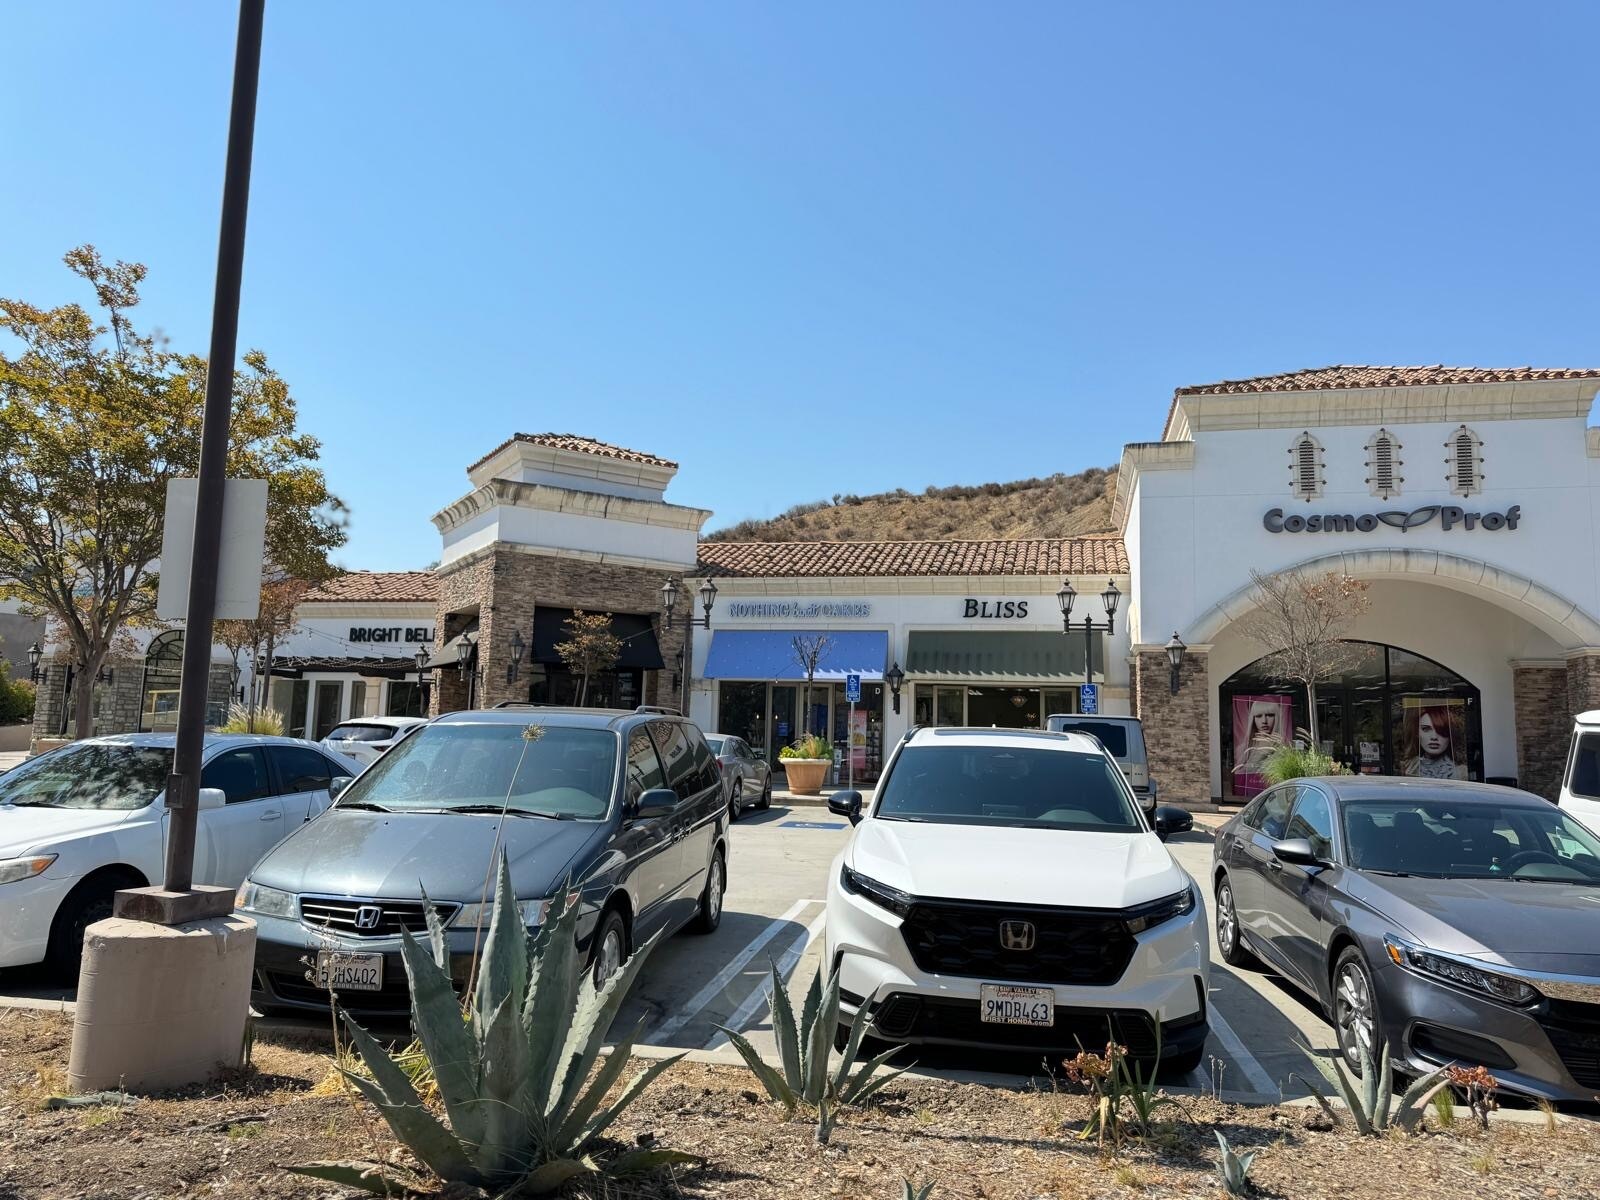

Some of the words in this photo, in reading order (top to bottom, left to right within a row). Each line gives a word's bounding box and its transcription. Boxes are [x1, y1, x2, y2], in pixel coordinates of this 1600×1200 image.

[1263, 507, 1378, 533] Cosmo
[1441, 504, 1521, 531] Prof
[729, 603, 790, 618] NOTHING
[822, 603, 871, 618] CAKES
[349, 627, 402, 643] BRIGHT
[1468, 697, 1473, 706] F
[987, 1000, 1048, 1020] 9MDB463
